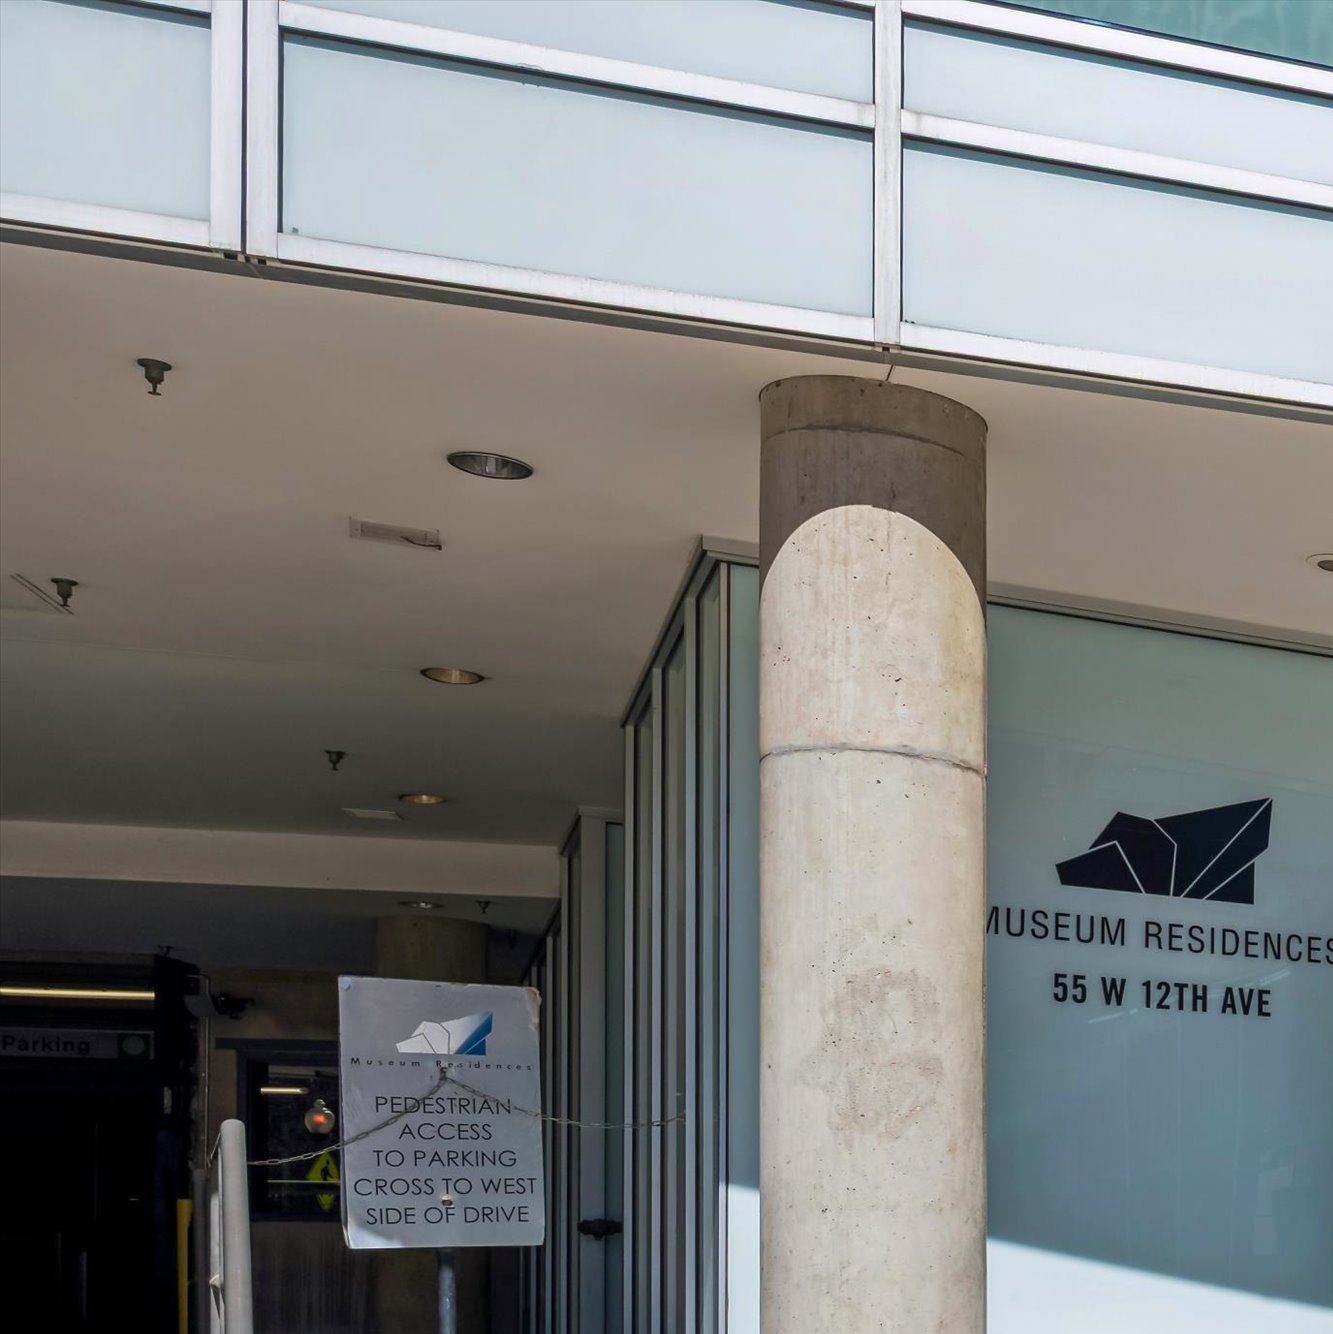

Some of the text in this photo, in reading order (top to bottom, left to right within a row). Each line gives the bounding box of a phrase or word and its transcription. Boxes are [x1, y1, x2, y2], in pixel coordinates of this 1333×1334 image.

[1053, 973, 1271, 1017] 55 W 12TH AVE
[2, 1035, 91, 1055] Parking
[351, 1057, 532, 1071] Museum Residences
[375, 1096, 511, 1115] PEDESTRIAN
[398, 1123, 493, 1141] ACCESS
[373, 1150, 517, 1167] TO PARKING
[354, 1177, 537, 1196] CROSS TO WEST
[366, 1206, 529, 1225] SIDE OF DRIVE
